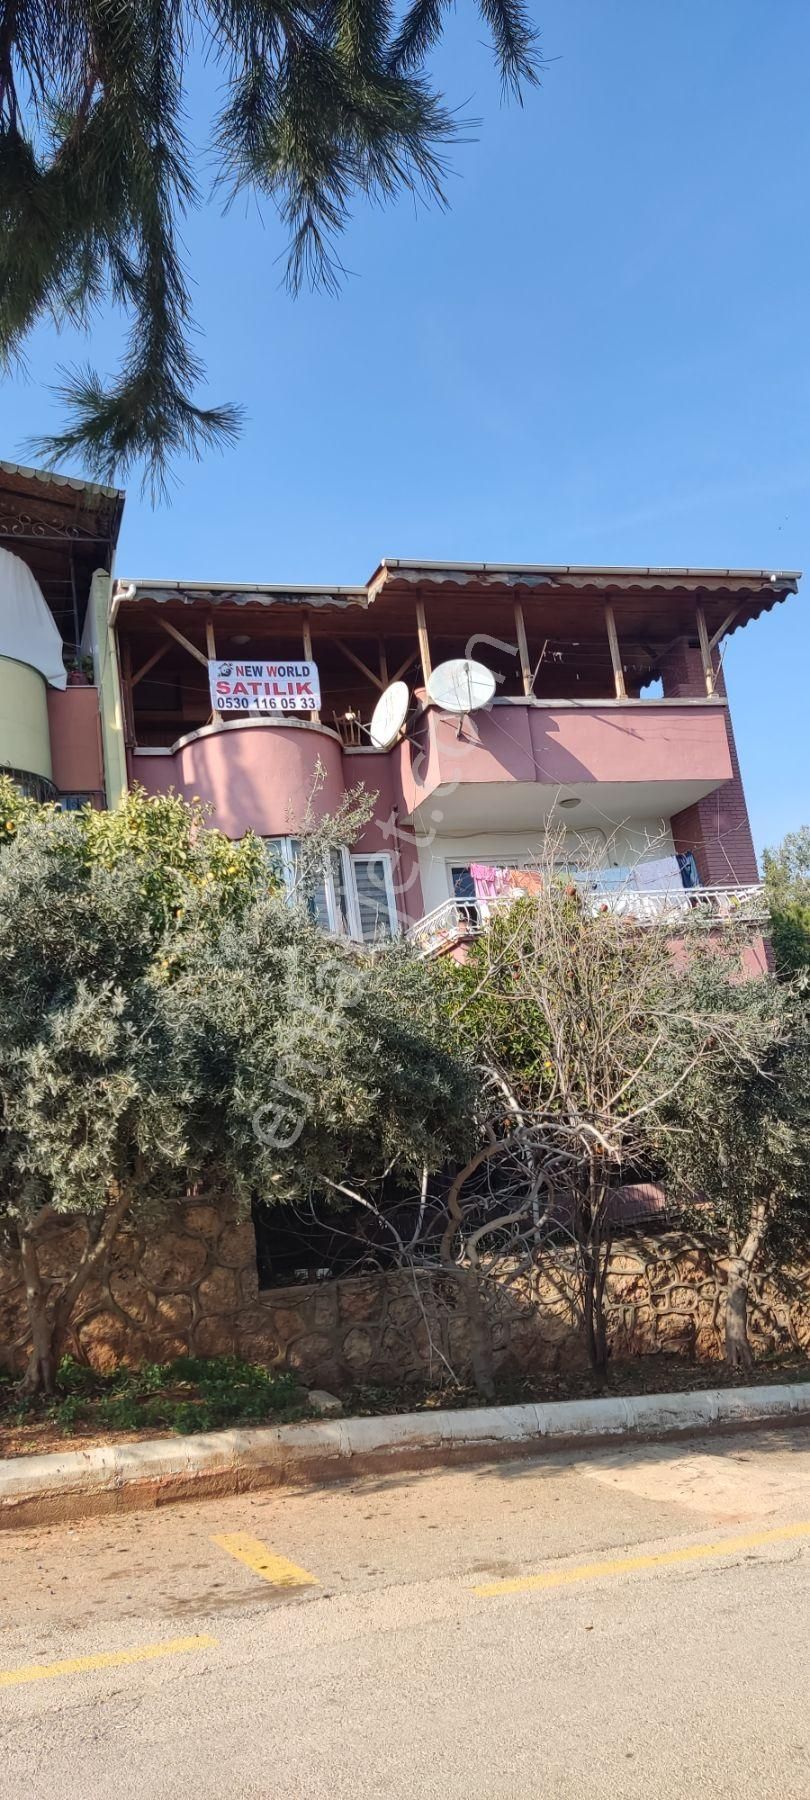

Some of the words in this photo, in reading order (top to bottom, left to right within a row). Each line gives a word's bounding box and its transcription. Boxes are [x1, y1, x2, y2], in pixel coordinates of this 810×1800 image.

[236, 666, 263, 677] NEW
[266, 666, 310, 677] WORLD
[216, 681, 314, 696] SATILIK
[217, 697, 249, 709] 0530
[253, 698, 277, 709] 116
[281, 698, 296, 709] 05
[301, 698, 316, 709] 33
